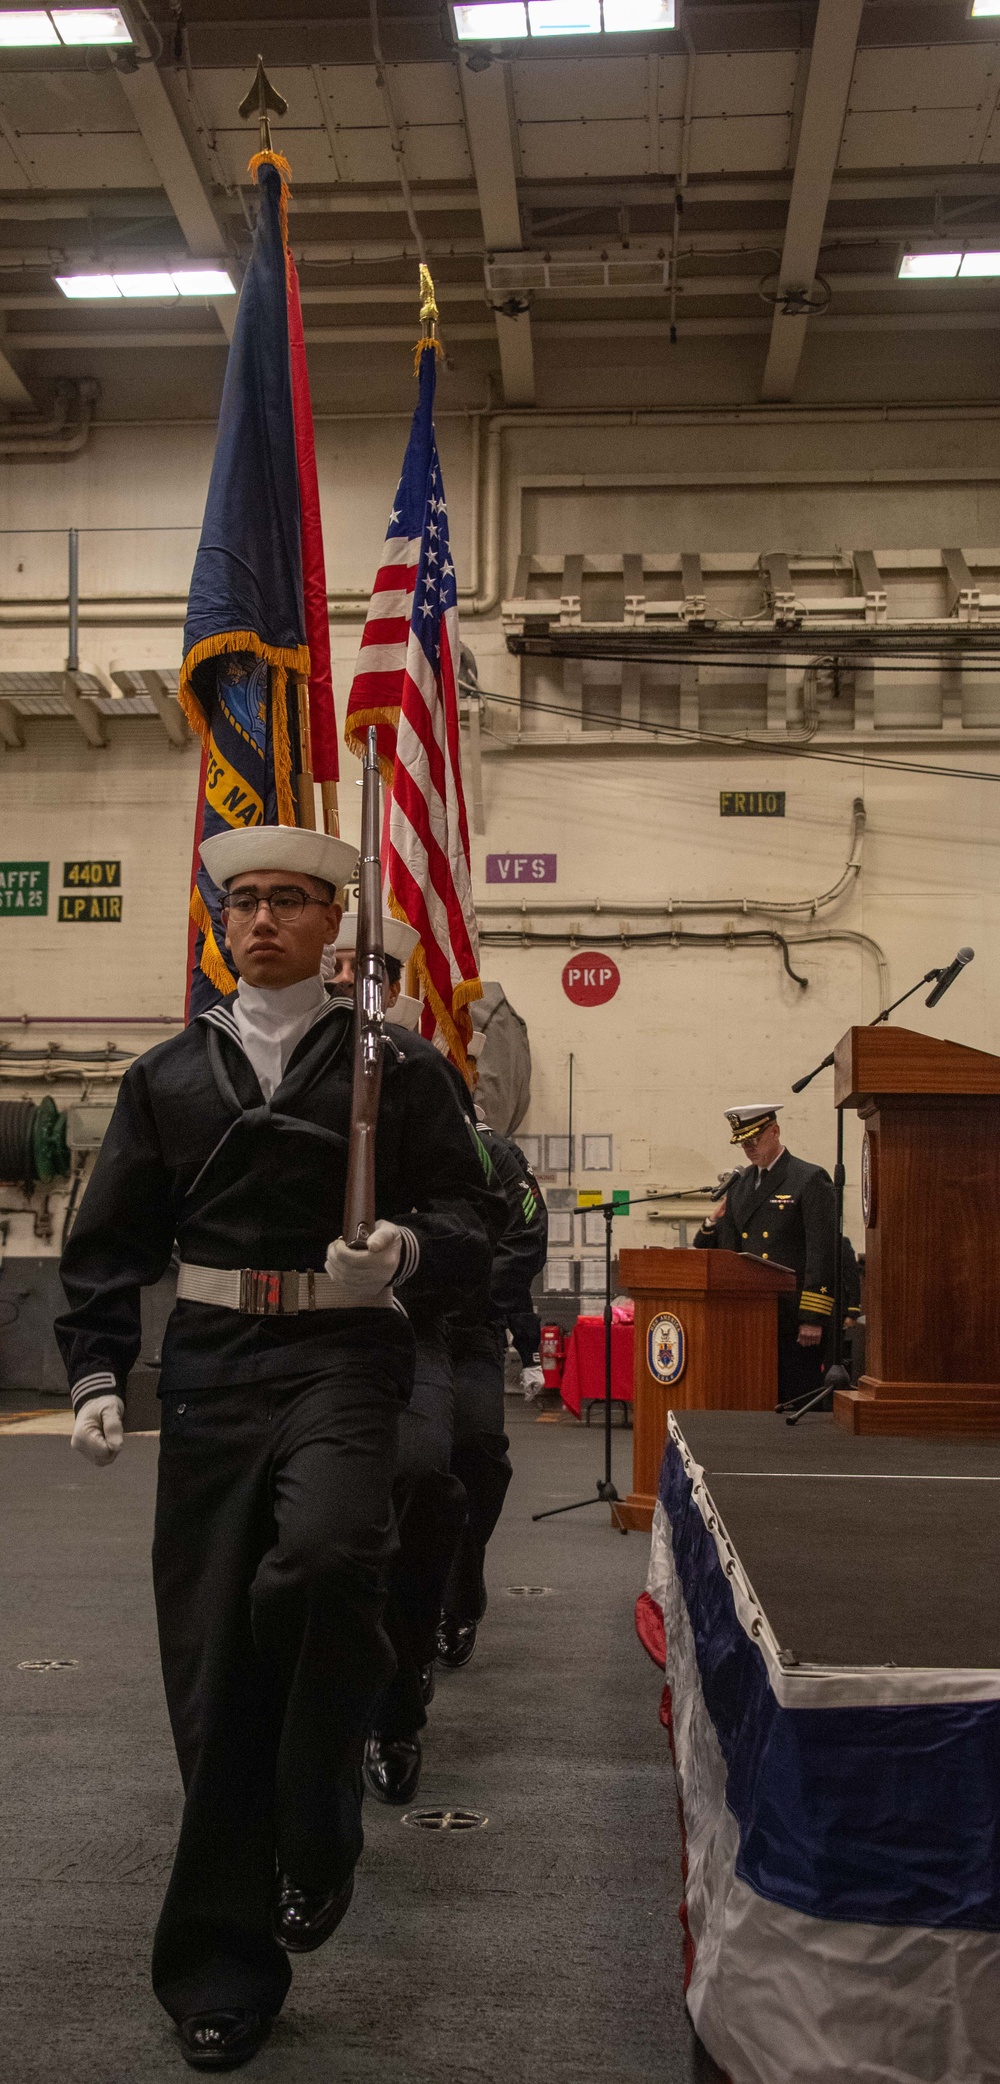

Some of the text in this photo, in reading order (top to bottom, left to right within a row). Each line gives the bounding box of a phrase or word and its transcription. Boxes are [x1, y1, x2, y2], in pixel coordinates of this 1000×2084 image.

[721, 793, 777, 813] FR110
[498, 859, 545, 879] VFS
[28, 890, 43, 908] 25
[63, 897, 121, 919] LP AIR
[568, 968, 612, 987] PKP
